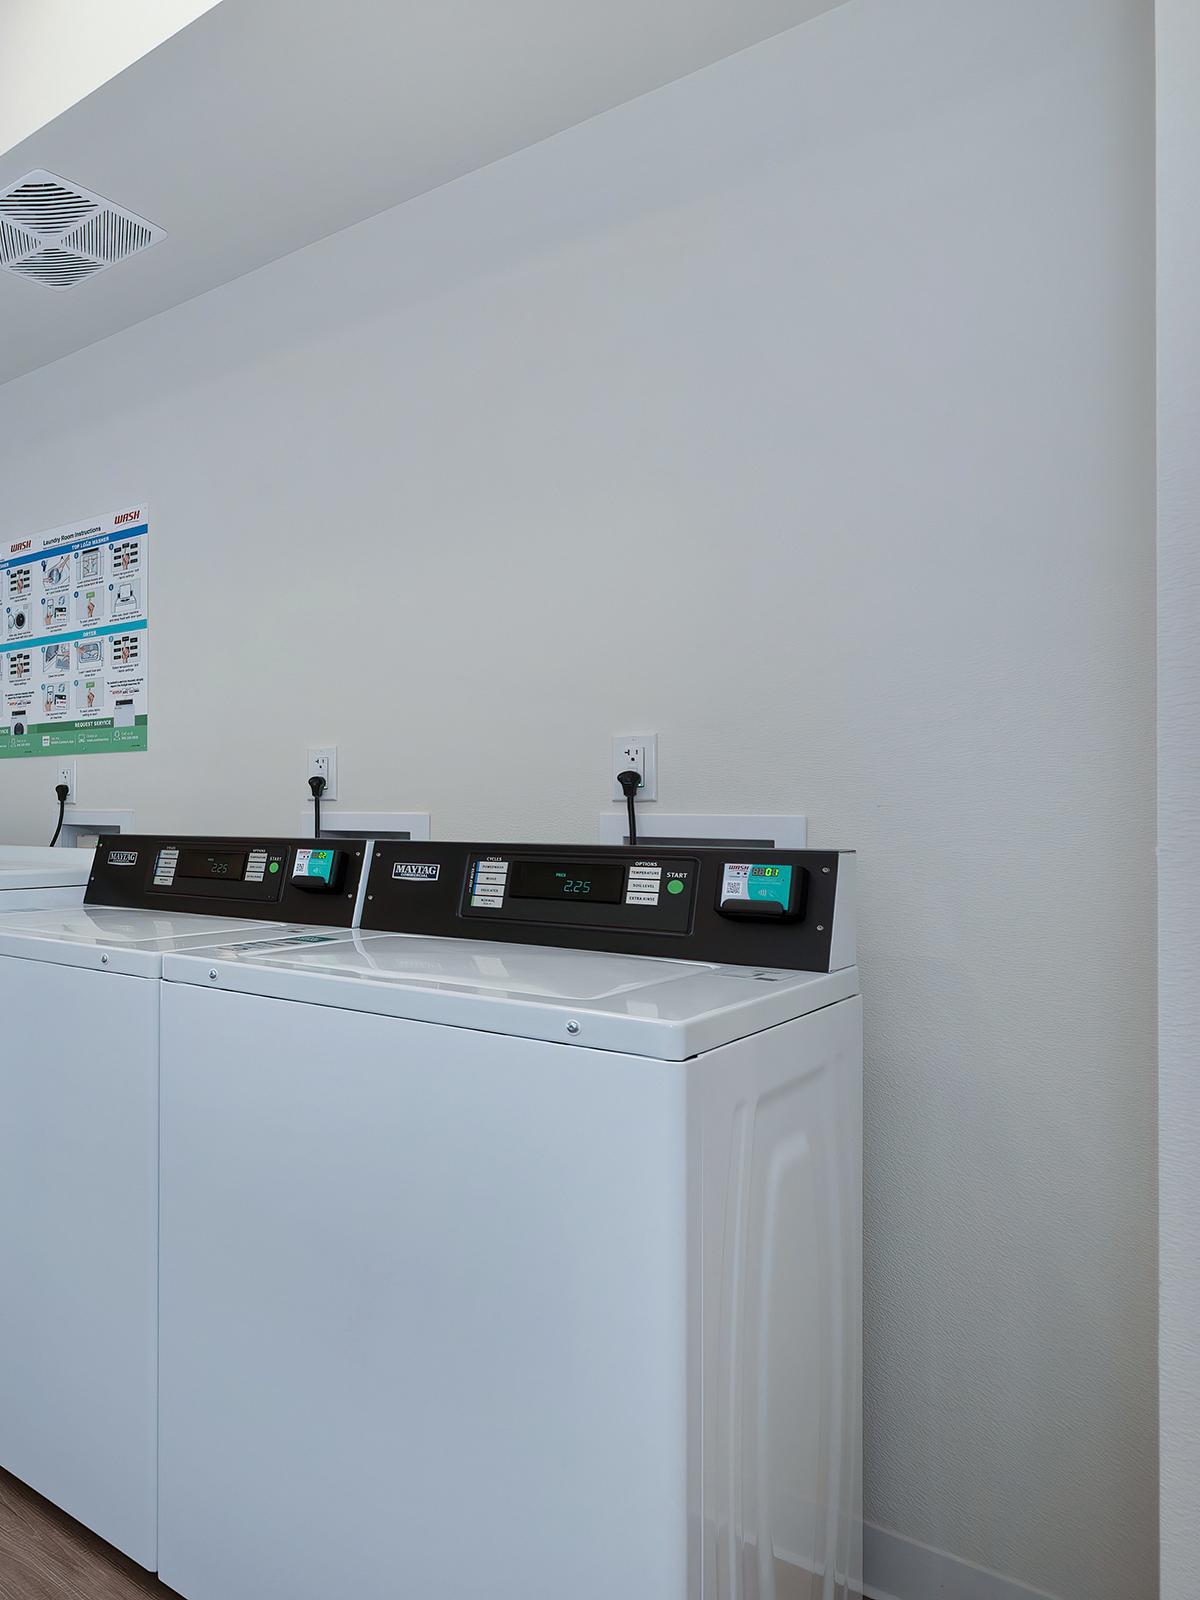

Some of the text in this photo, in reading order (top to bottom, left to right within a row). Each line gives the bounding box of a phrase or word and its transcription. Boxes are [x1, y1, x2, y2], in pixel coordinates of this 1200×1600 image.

[114, 510, 140, 524] WASH
[43, 526, 101, 546] Laundry Room Instructions
[11, 540, 31, 552] WASH
[110, 852, 135, 861] MAYTAG
[211, 863, 228, 873] 2.25
[396, 865, 436, 874] MAYTAG
[563, 880, 591, 893] 2.25
